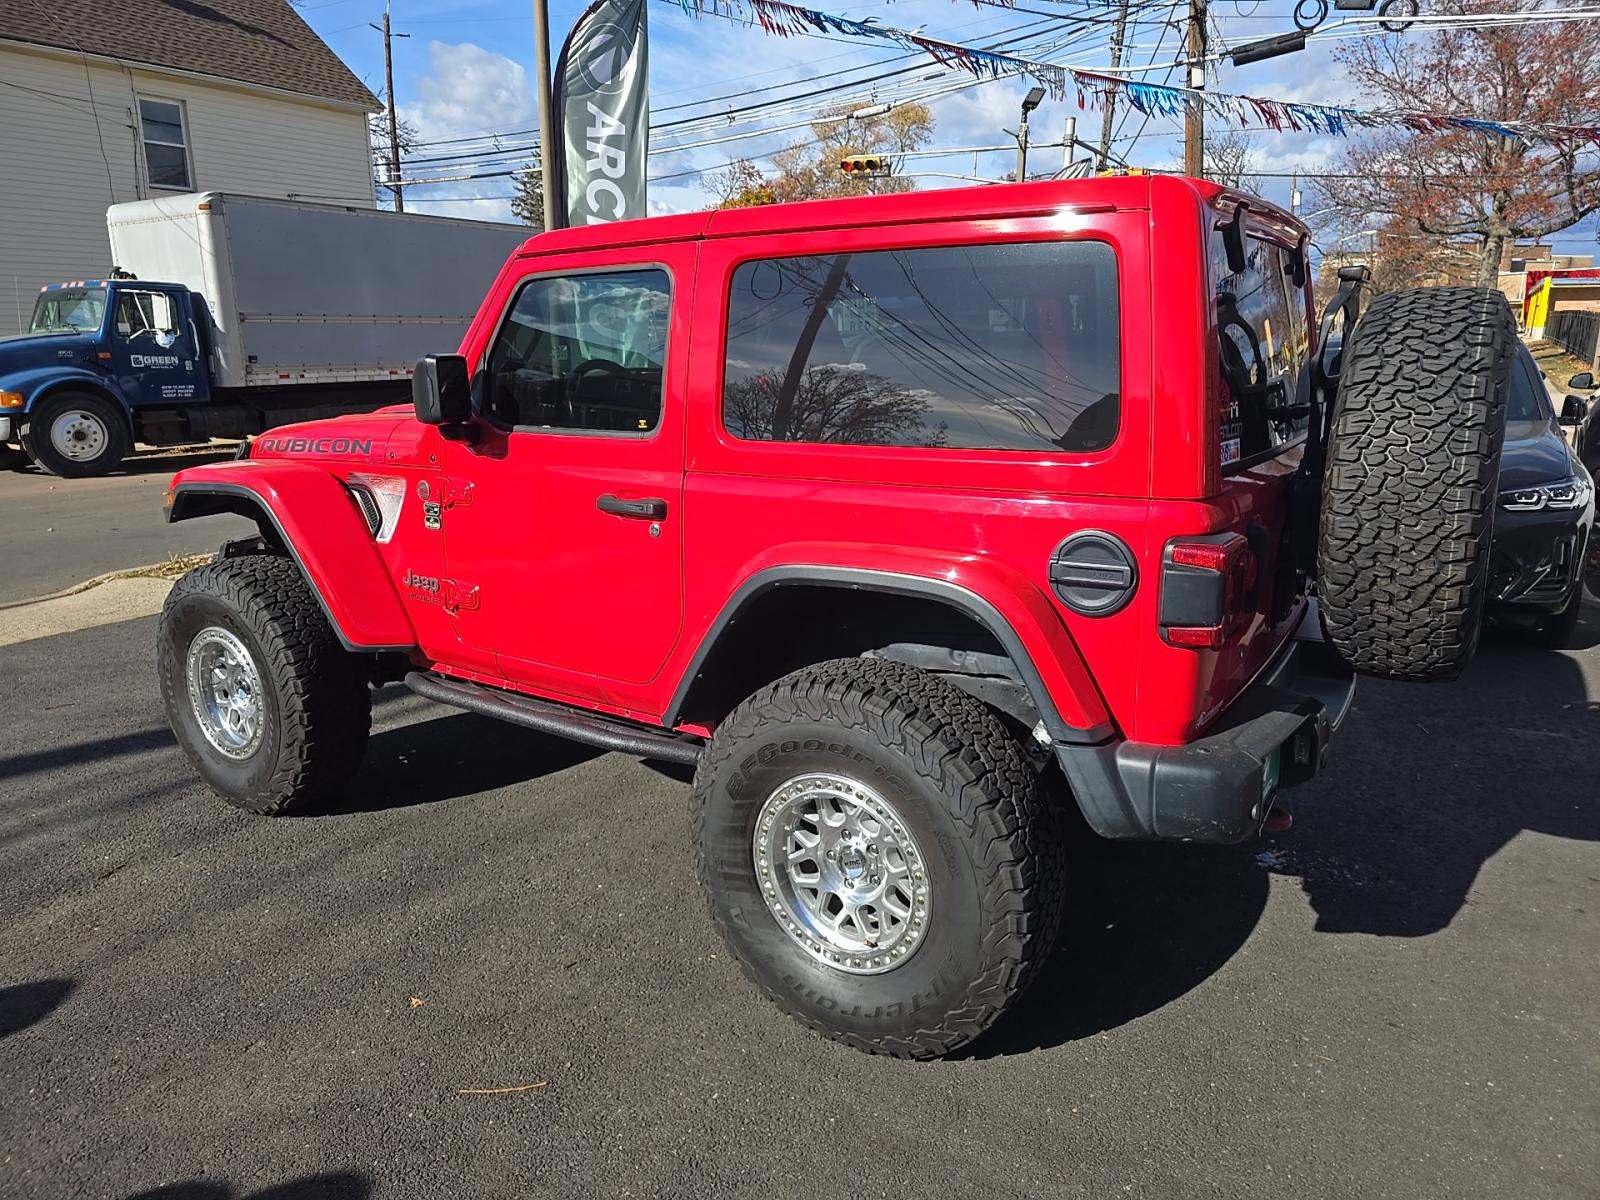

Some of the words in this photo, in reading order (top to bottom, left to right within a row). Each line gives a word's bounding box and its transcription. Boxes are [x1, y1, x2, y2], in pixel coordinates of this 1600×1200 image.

[586, 101, 626, 225] ARC
[143, 355, 179, 365] GREEN
[259, 438, 373, 454] RUBICON
[403, 568, 440, 594] Jeep
